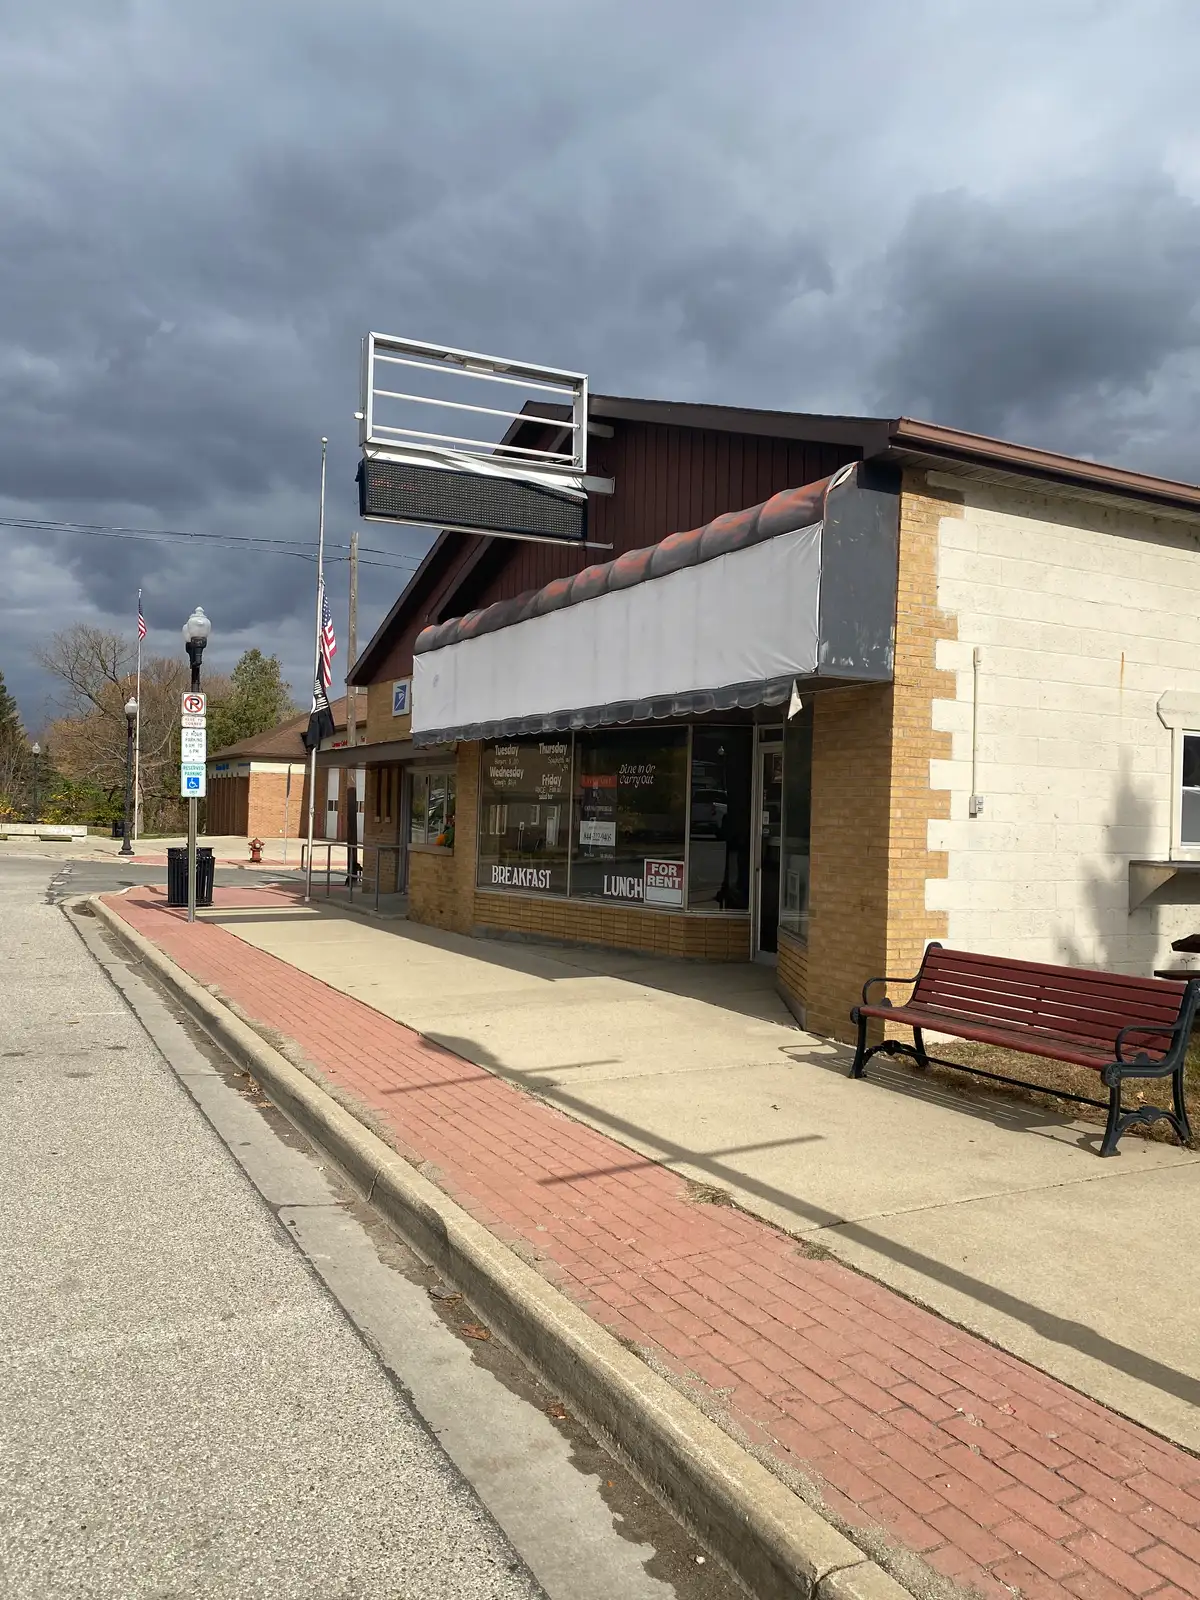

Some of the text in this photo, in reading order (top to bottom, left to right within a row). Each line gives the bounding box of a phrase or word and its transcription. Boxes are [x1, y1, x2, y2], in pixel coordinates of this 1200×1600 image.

[495, 742, 568, 757] Tuesday Thursday
[489, 766, 525, 780] Wednesday
[618, 763, 636, 774] Dine
[645, 763, 656, 774] Or
[541, 774, 562, 787] Friday
[619, 774, 655, 789] Carry Out
[491, 864, 552, 889] BREAKFAST
[651, 863, 677, 876] FOR
[603, 874, 643, 899] LUNCH
[646, 874, 682, 889] RENT
